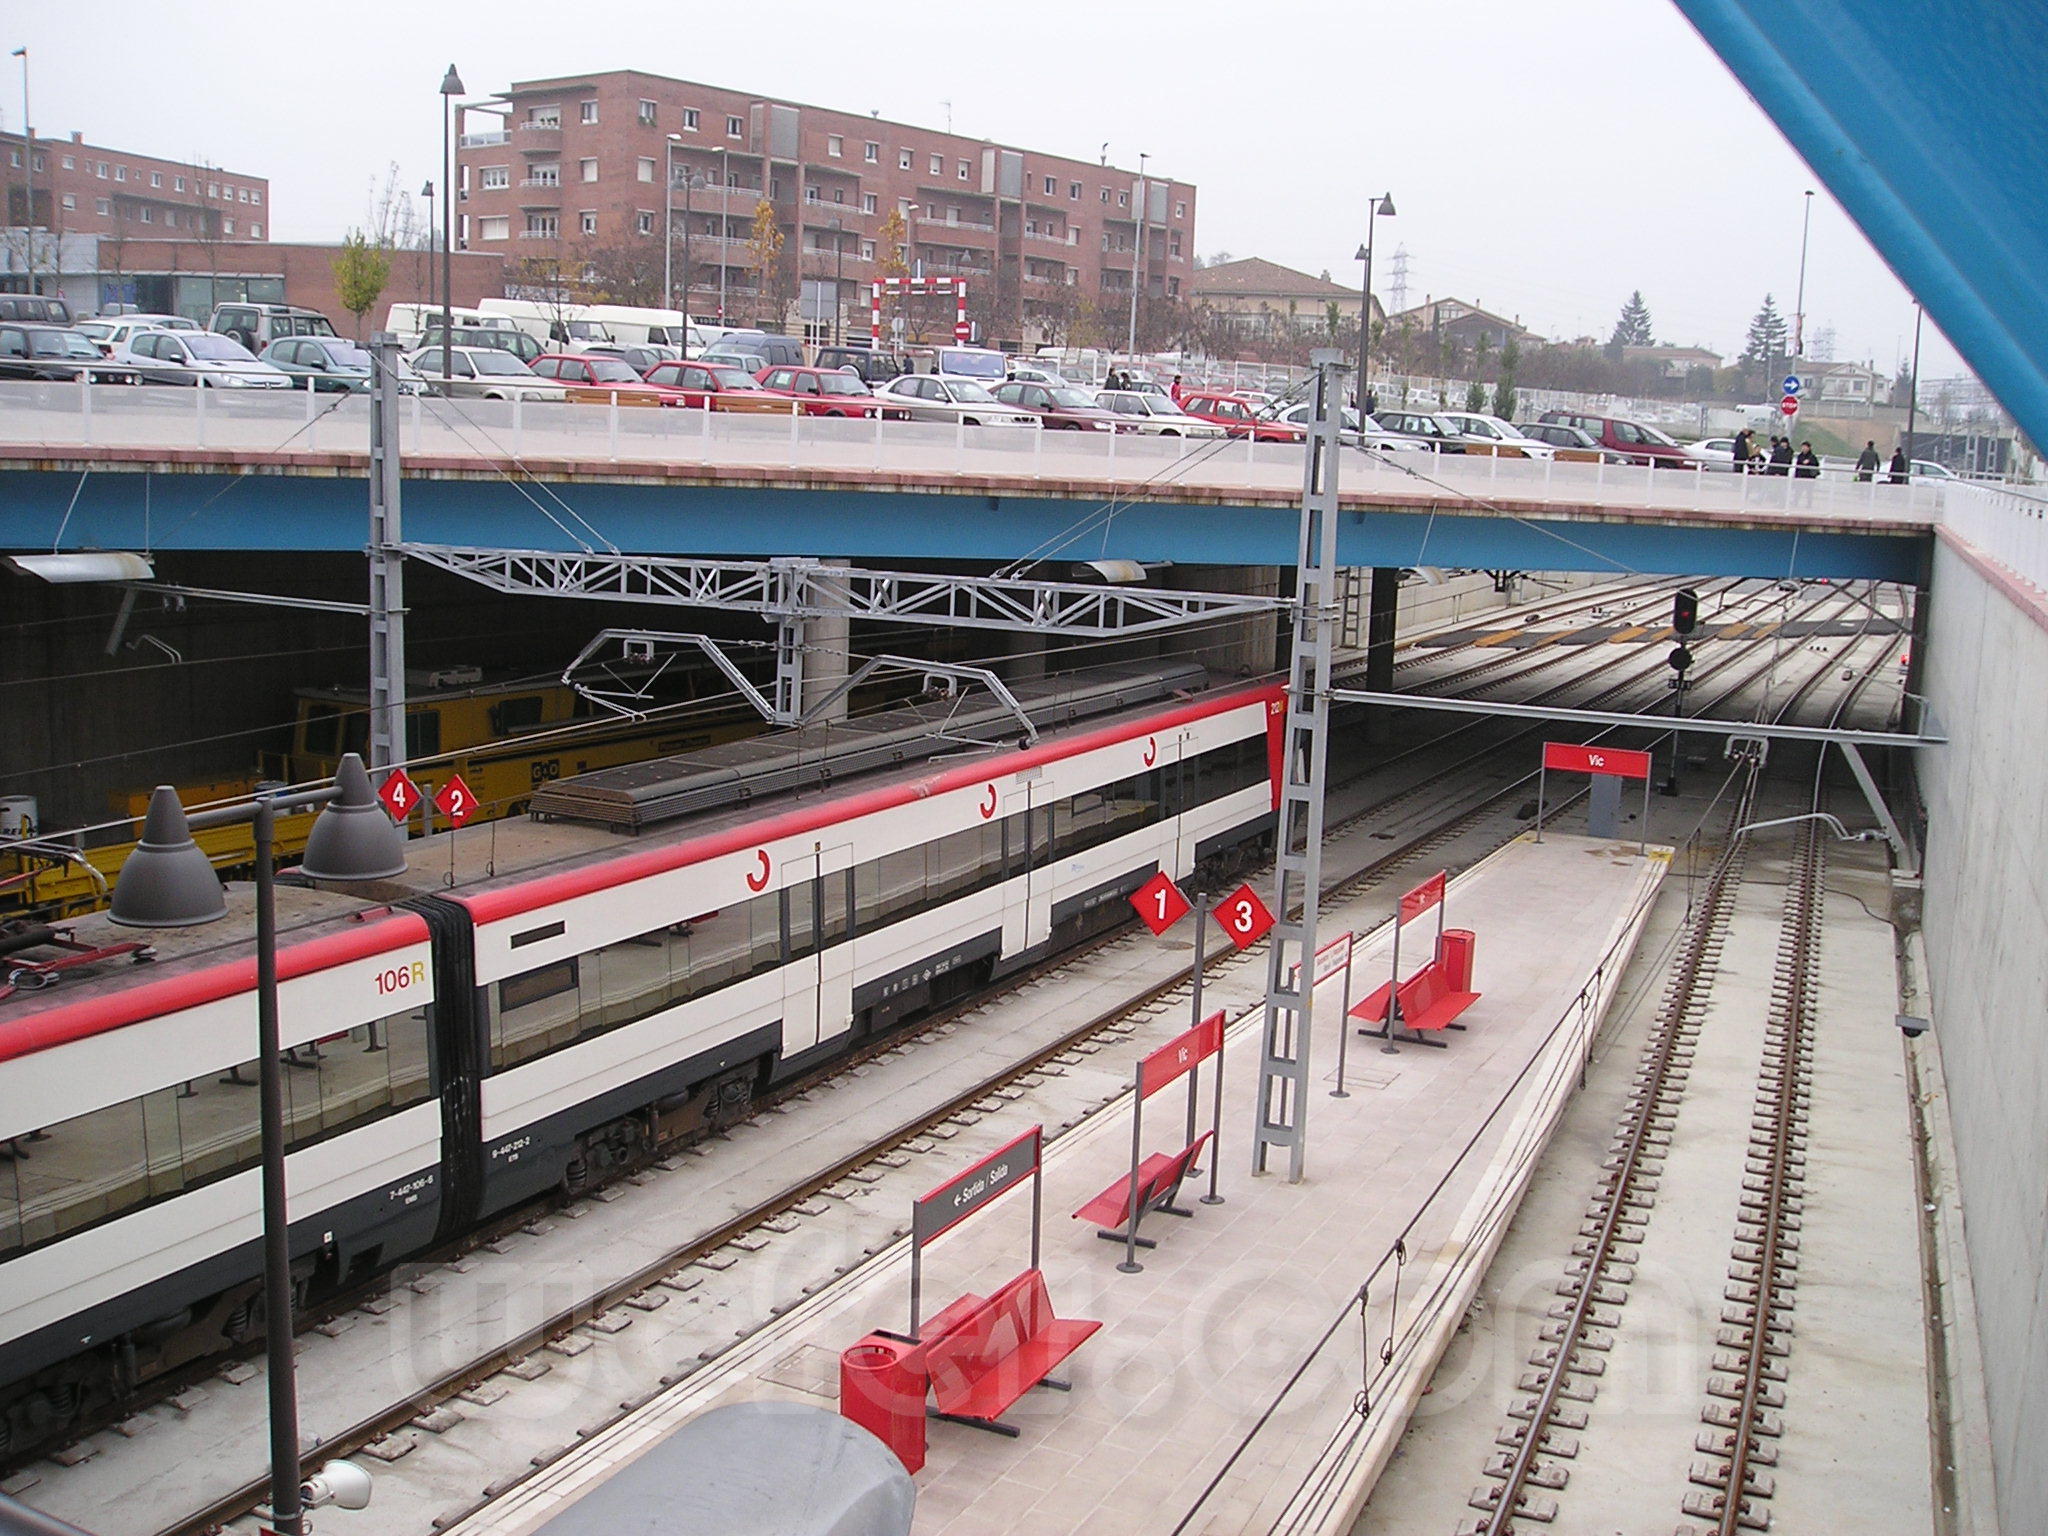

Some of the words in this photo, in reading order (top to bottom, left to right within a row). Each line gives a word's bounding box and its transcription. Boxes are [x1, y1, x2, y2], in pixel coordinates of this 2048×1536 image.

[1782, 401, 1798, 409] STOP
[1588, 753, 1605, 768] Vic
[392, 781, 406, 808] 4
[450, 789, 464, 816] 2
[1153, 888, 1167, 920] 1
[1233, 899, 1254, 933] 3
[374, 960, 425, 995] 106R
[962, 1178, 985, 1203] Sortida
[989, 1163, 1009, 1185] Salida
